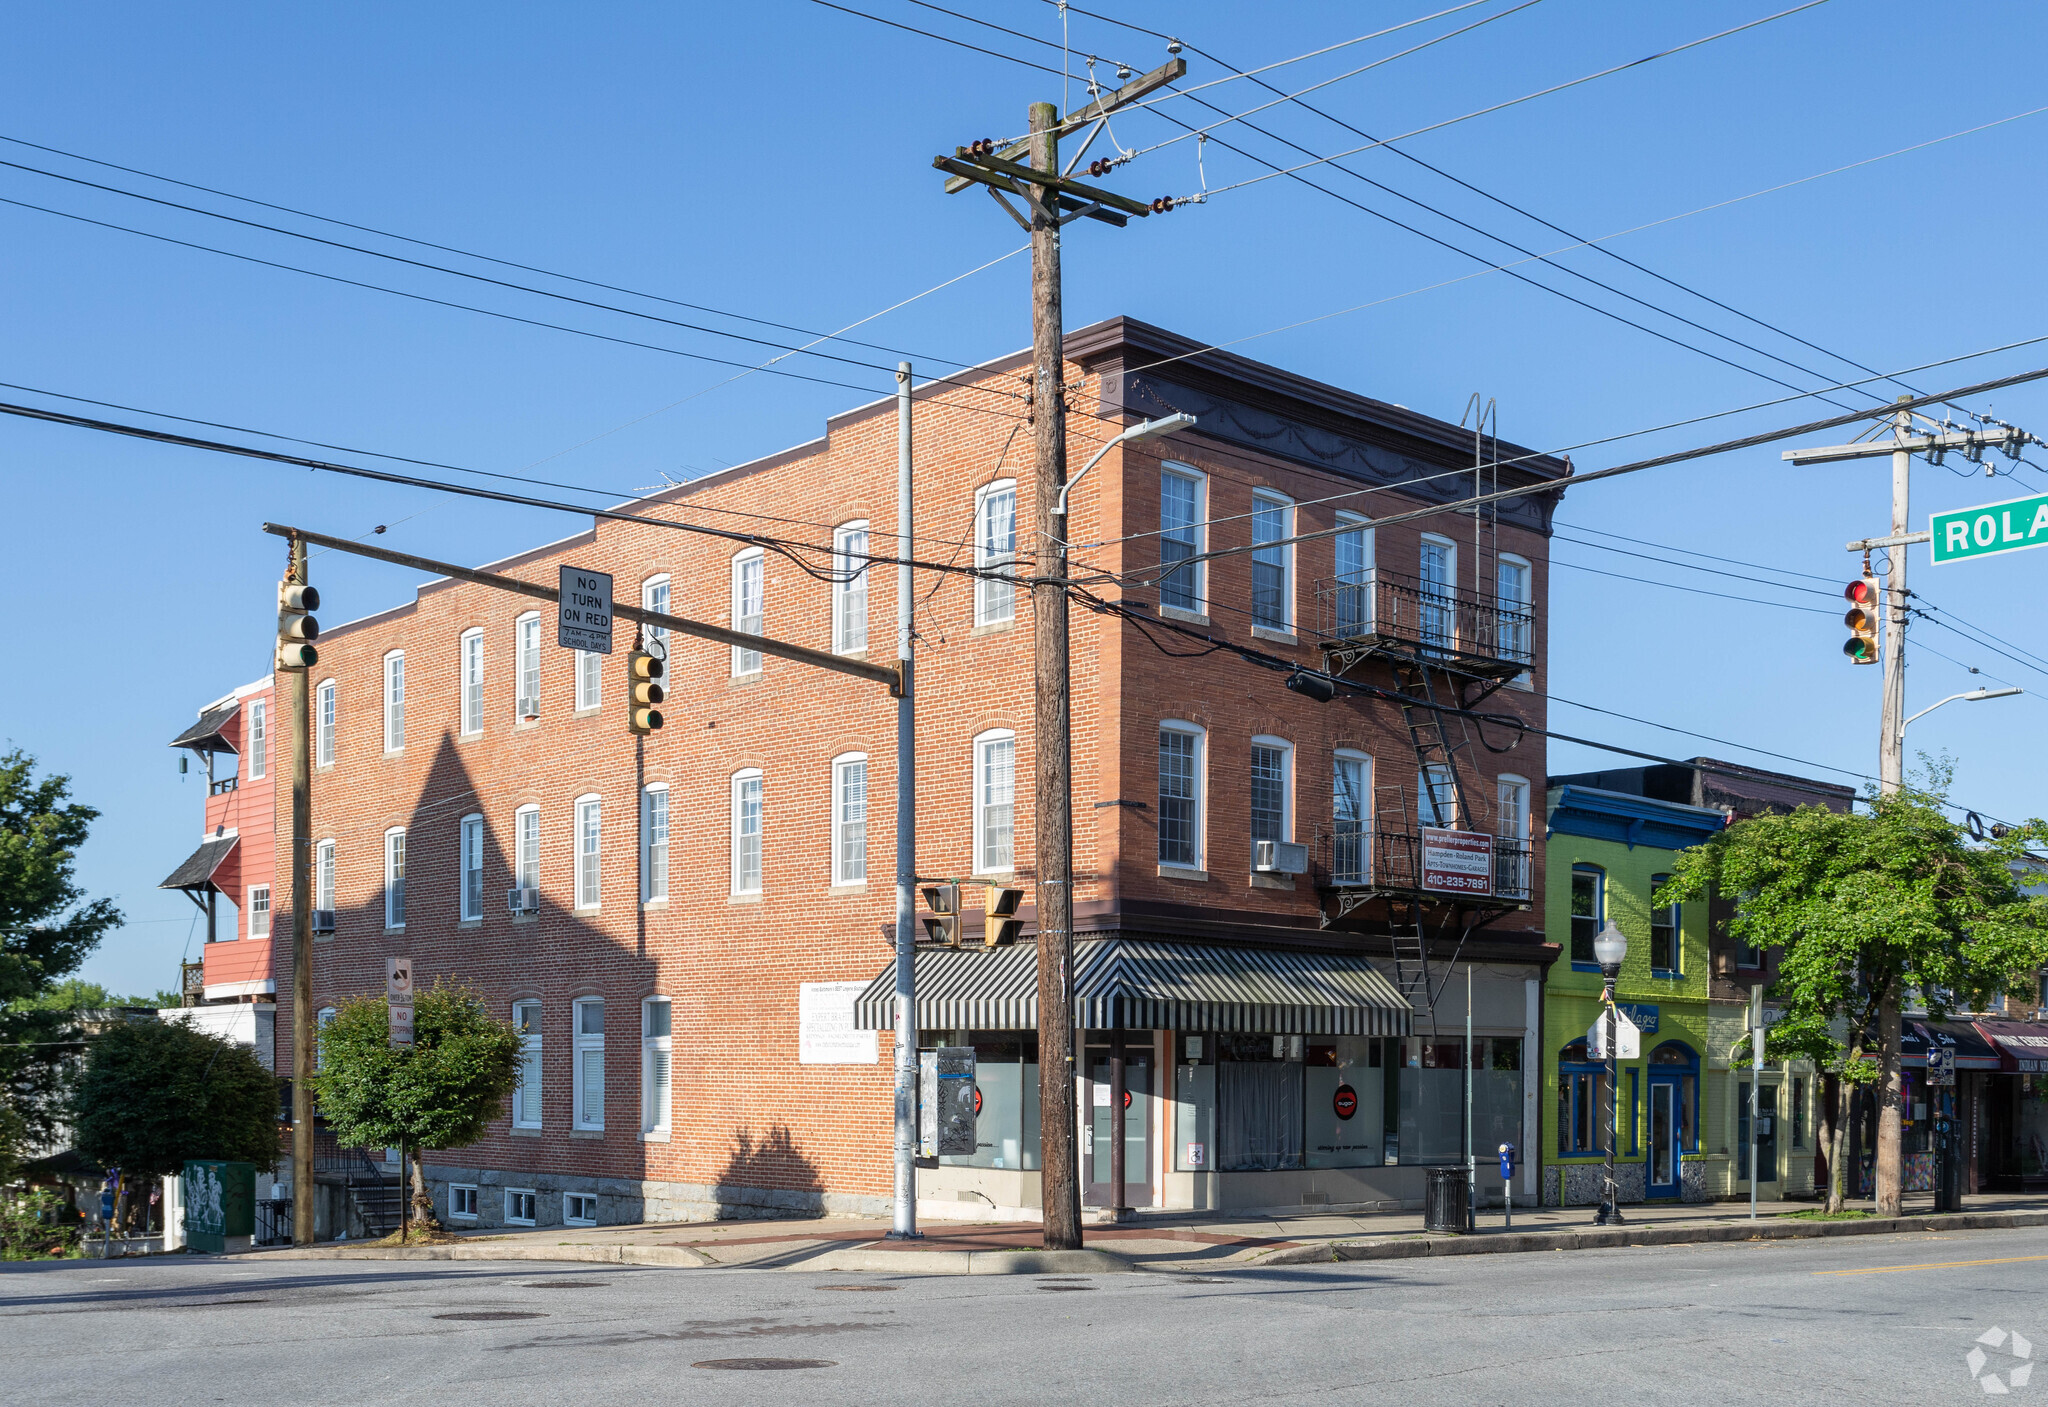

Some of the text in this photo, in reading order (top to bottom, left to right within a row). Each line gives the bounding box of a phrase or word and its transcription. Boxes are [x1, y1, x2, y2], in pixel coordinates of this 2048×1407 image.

[1946, 504, 2048, 553] ROLA
[577, 577, 597, 591] NO
[571, 593, 602, 609] TURN
[564, 609, 608, 627] ON RED
[563, 637, 607, 651] SCHOOL DAYS
[1474, 854, 1486, 862] Park
[1427, 874, 1488, 890] 410-235-7891
[397, 1011, 407, 1021] NO
[392, 1025, 413, 1035] STOPPING
